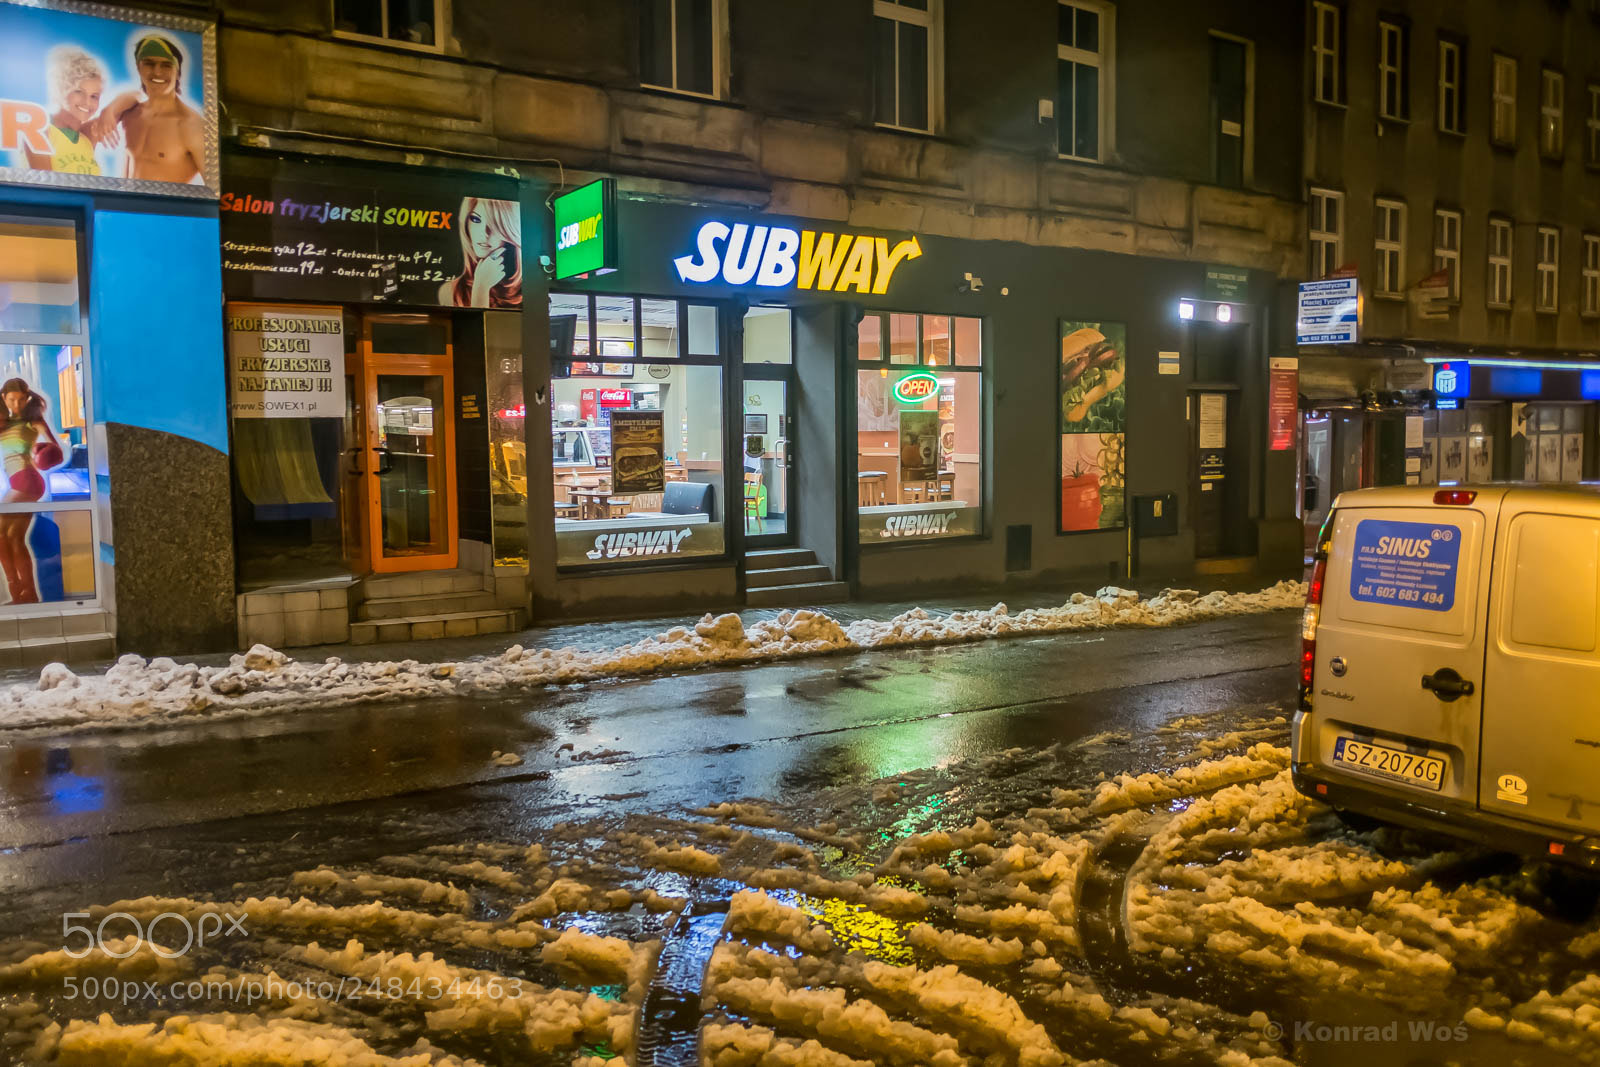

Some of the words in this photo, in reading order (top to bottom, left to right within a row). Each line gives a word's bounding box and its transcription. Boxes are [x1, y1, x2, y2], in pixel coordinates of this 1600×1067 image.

[220, 193, 274, 214] Salon
[280, 198, 379, 224] fryzjerski
[383, 207, 453, 230] SOWEX
[558, 213, 602, 251] SUBWAY
[674, 222, 922, 295] SUBWAY
[230, 317, 342, 335] ROFESJONALNE
[259, 337, 311, 353] USŁUGI
[238, 357, 331, 373] FRYZJERSKIE
[238, 376, 314, 392] NAJTANIEJ
[316, 377, 333, 392] !!!
[900, 379, 935, 396] OPEN
[231, 401, 317, 413] www.SOWEX1.pl
[880, 511, 958, 538] SUBWAY
[586, 527, 693, 559] SUBWAY
[1376, 536, 1432, 559] SINUS
[1358, 584, 1374, 596] tel.
[1376, 586, 1396, 599] 602
[1398, 588, 1420, 602] 683
[1422, 591, 1445, 605] 494
[1347, 743, 1373, 767] SZ
[1378, 750, 1439, 782] 2076G
[1505, 778, 1522, 792] PL
